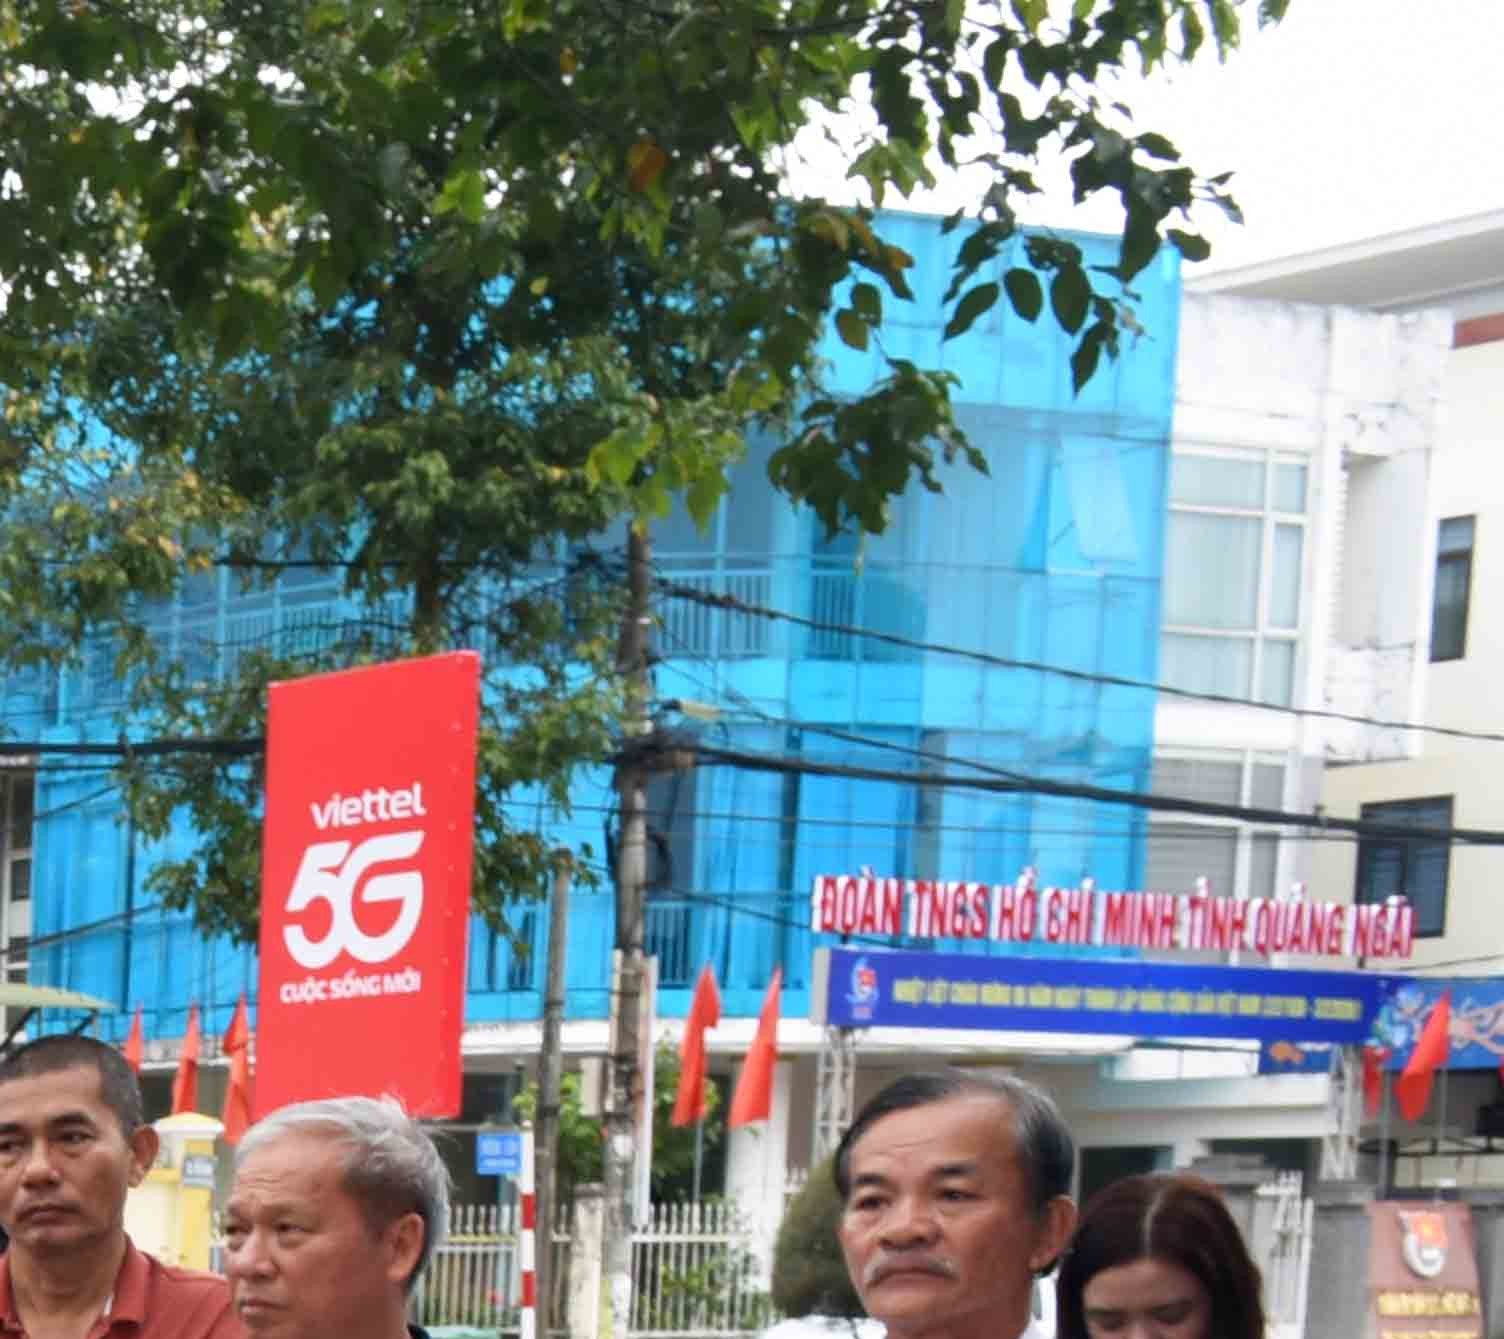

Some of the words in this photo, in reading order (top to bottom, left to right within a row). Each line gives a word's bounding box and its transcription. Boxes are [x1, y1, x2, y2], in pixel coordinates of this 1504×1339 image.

[311, 780, 428, 830] viettel
[283, 829, 426, 970] 5G
[812, 865, 904, 937] ĐOÀN
[989, 866, 1040, 942] HỒ
[1041, 876, 1097, 945] CHÍ
[1097, 890, 1178, 949] MINH
[1178, 876, 1248, 951] TỈNH
[1247, 880, 1343, 959] QUẢNG
[279, 975, 328, 1005] CUỘC
[329, 967, 382, 999] SỐNG
[383, 966, 422, 993] MỚI
